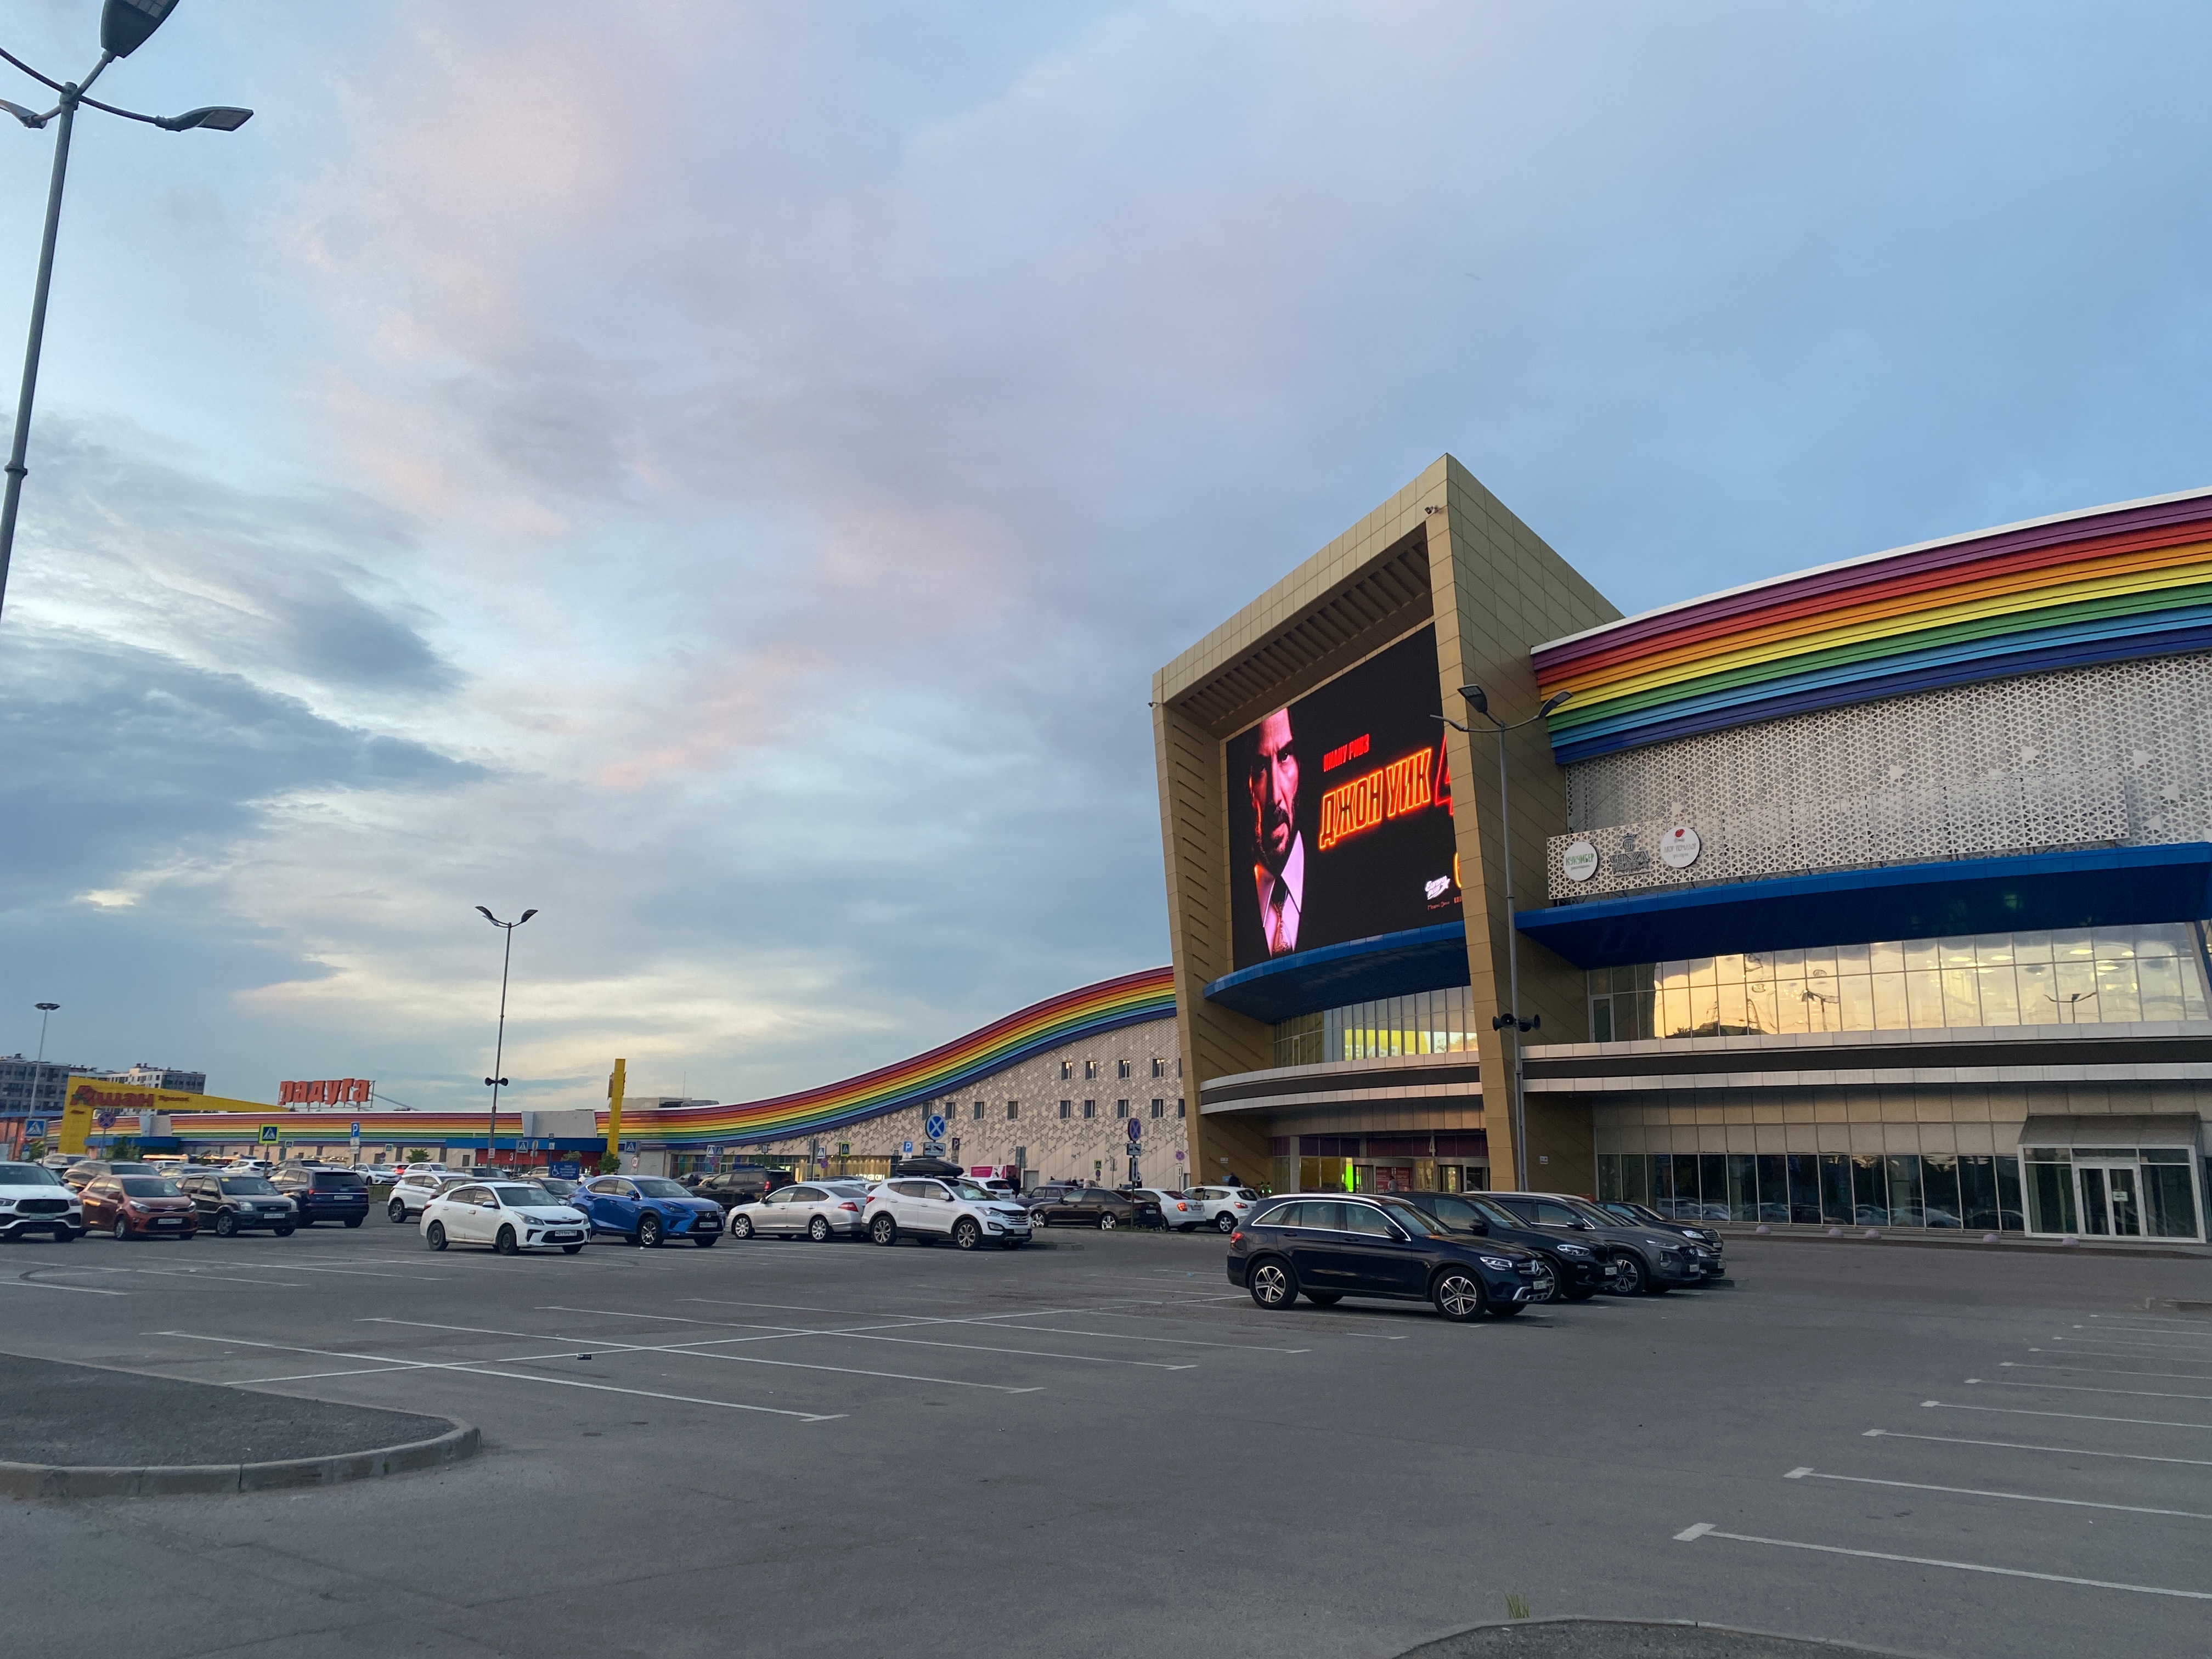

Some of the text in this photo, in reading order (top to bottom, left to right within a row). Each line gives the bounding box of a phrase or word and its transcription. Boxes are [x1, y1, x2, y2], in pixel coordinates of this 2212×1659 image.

[1319, 770, 1384, 850] ДЖОН
[1387, 748, 1432, 817] УИК
[1566, 853, 1594, 867] КУКУМБЕР
[1610, 850, 1650, 864] GINZA
[70, 1085, 154, 1107] Ашан
[278, 1078, 370, 1105] радуга
[353, 1124, 358, 1136] P
[905, 1143, 911, 1151] P
[953, 1139, 959, 1149] P
[1429, 1136, 1436, 1157] 4
[509, 1152, 514, 1161] 3
